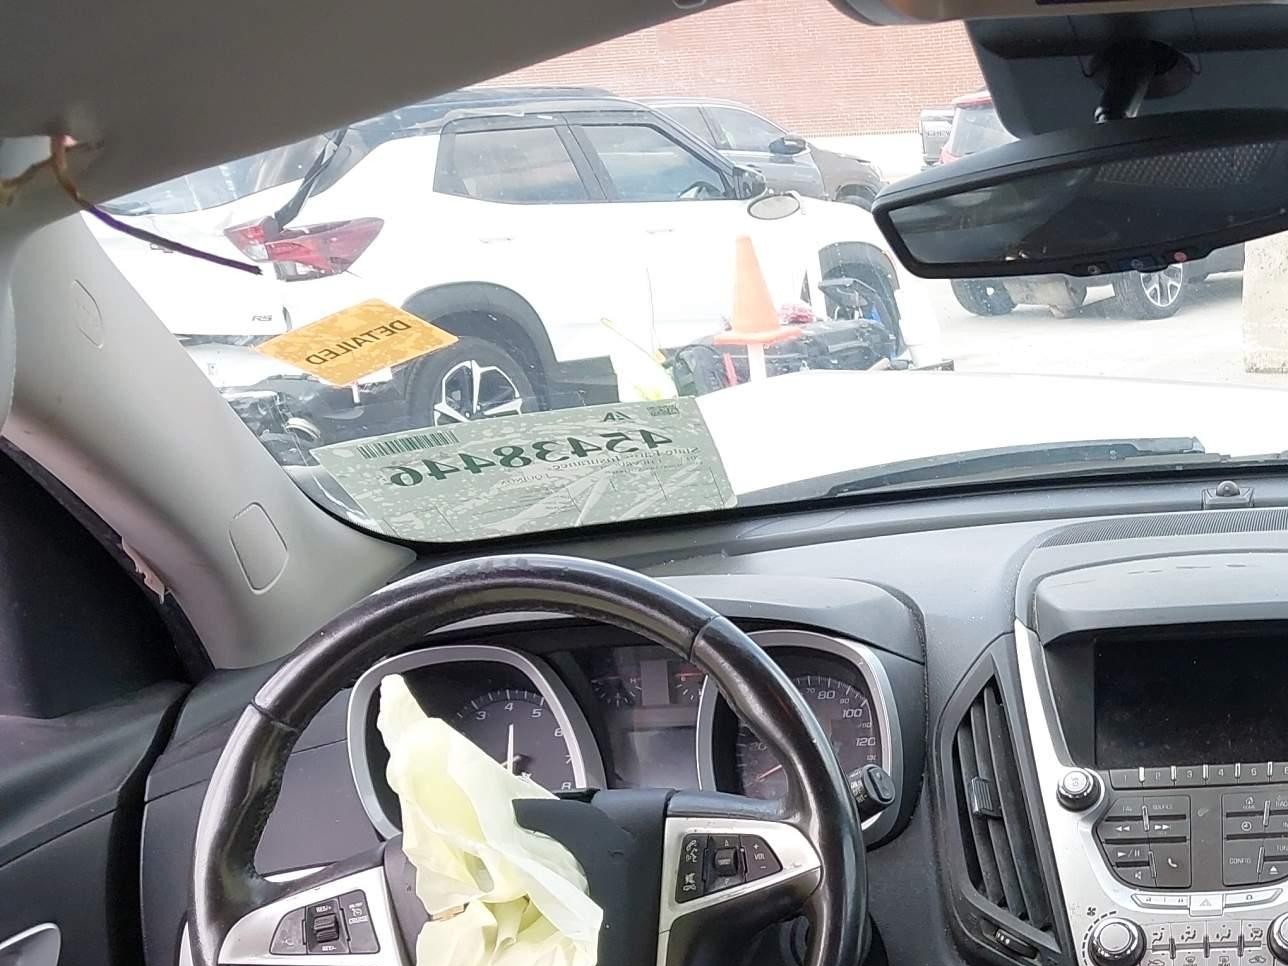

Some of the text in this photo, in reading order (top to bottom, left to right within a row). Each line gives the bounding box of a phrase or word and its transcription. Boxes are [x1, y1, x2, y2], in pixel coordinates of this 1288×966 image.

[251, 314, 273, 322] RS
[817, 690, 836, 700] 80
[504, 702, 514, 712] 4
[476, 711, 487, 720] 3
[531, 708, 542, 718] 5
[842, 708, 863, 718] 100
[855, 737, 876, 747] 120
